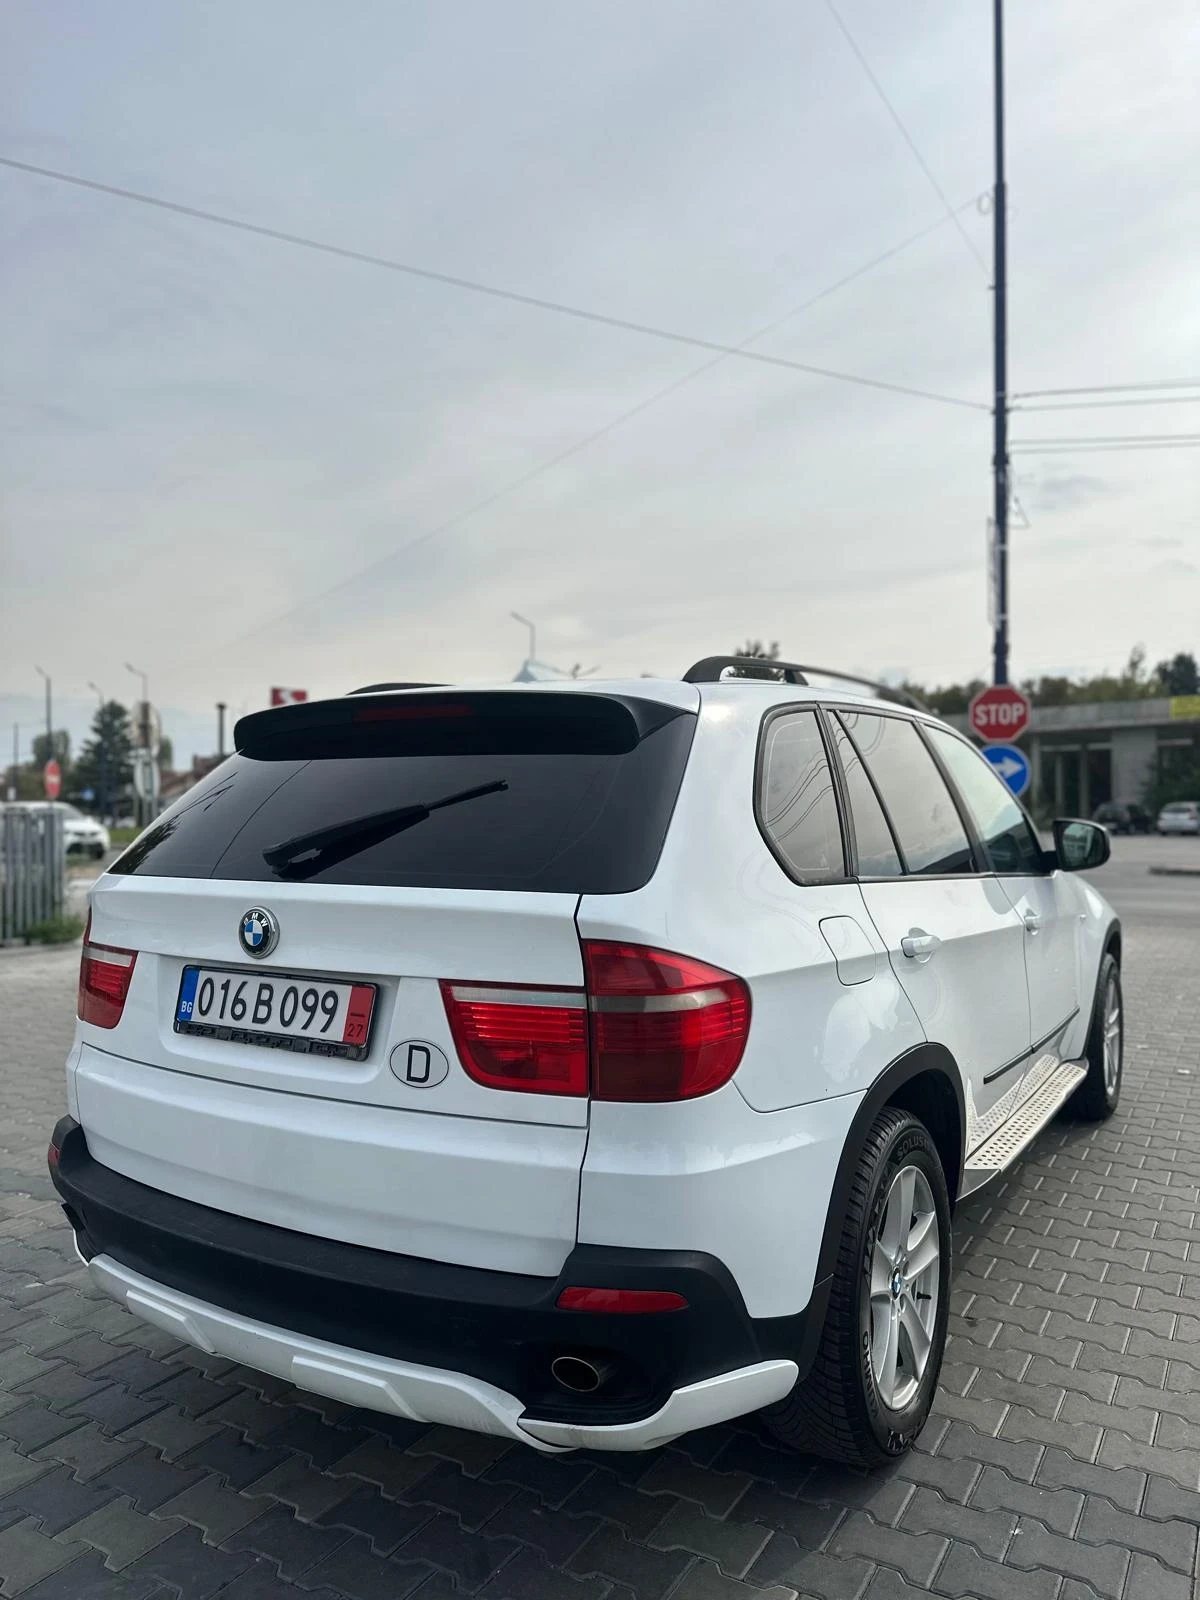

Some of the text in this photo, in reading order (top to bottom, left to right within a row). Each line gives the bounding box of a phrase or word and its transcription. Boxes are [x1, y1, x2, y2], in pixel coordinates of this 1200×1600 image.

[975, 703, 1025, 726] STOP
[243, 912, 268, 927] BMW
[181, 1000, 193, 1013] BG
[348, 1022, 363, 1038] 27
[406, 1044, 431, 1083] D
